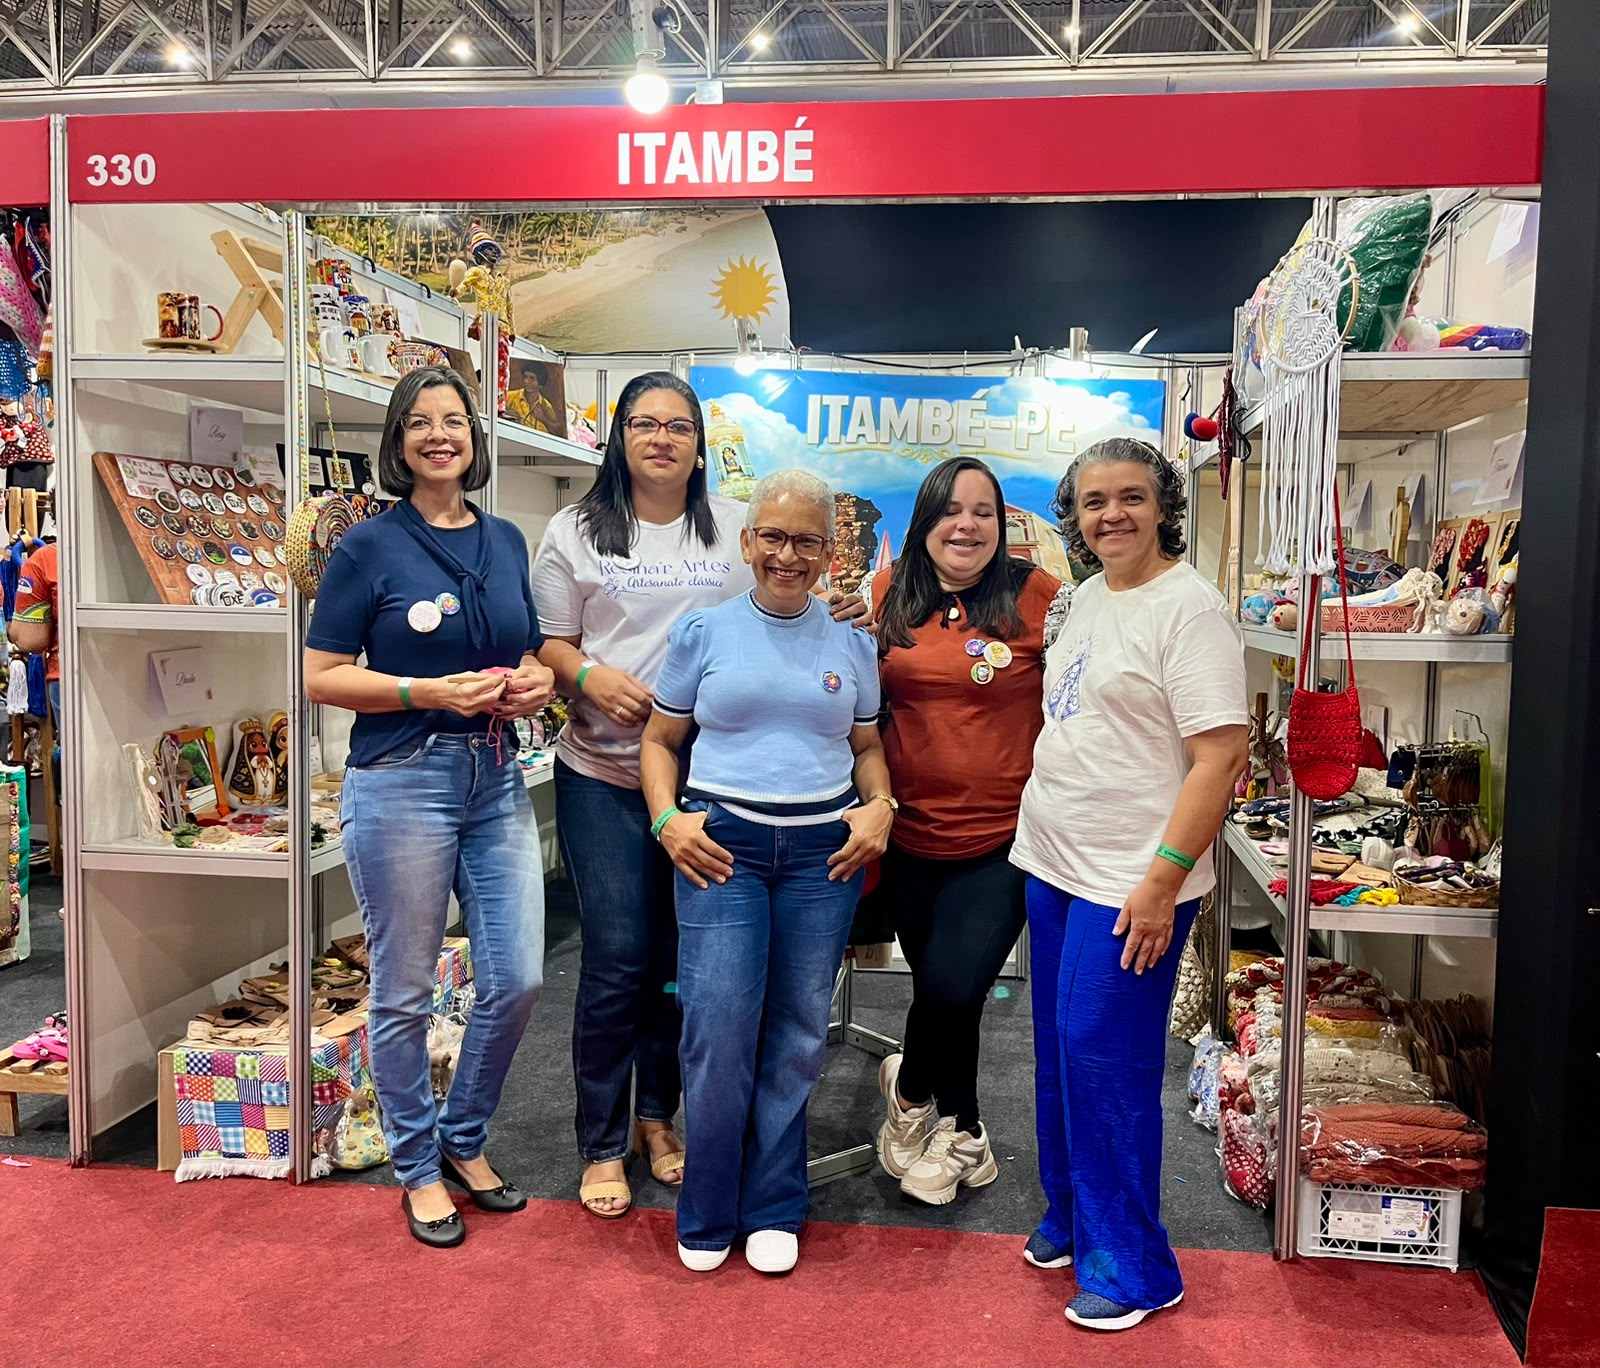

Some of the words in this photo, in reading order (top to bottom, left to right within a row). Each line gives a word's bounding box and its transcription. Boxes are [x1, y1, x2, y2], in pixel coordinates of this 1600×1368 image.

[617, 116, 814, 185] ITAMBÉ
[86, 153, 156, 187] 330
[806, 388, 1076, 454] ITAMBÉ-PE
[679, 558, 731, 574] Artes
[627, 576, 684, 589] Artesanato
[688, 574, 724, 588] clássico
[222, 593, 244, 606] OXE
